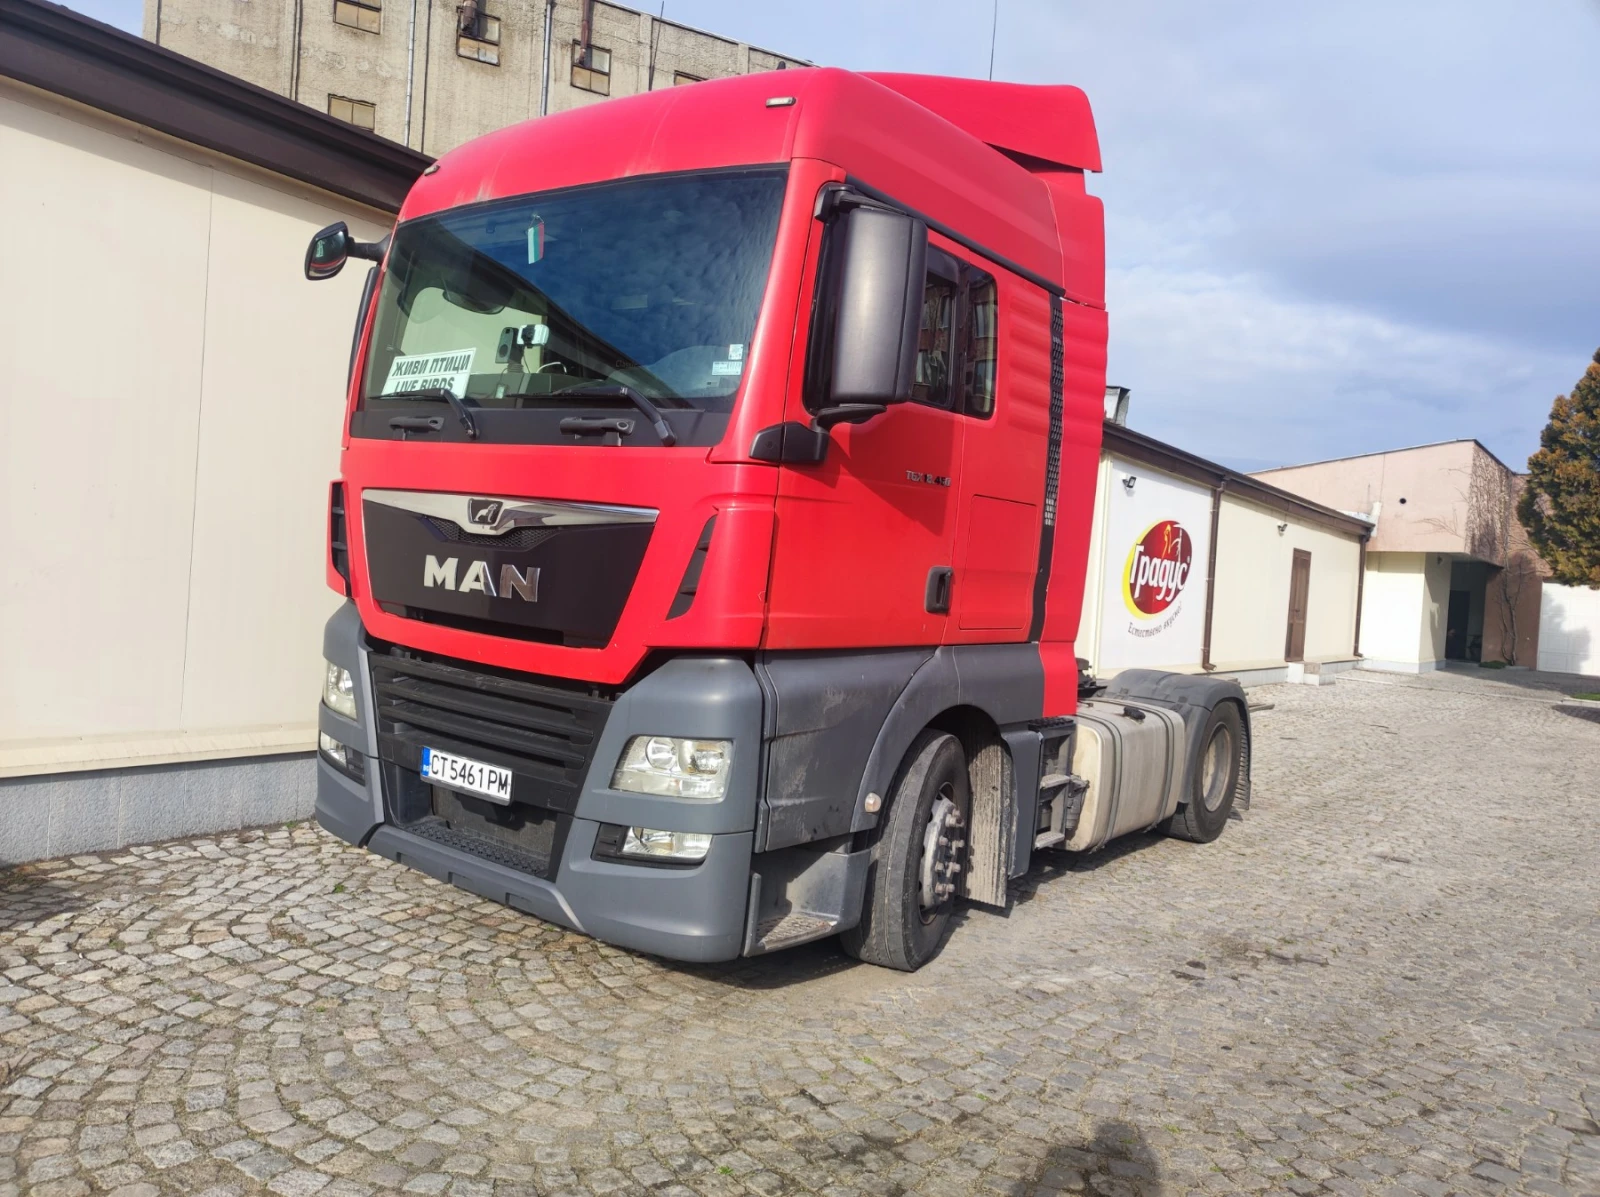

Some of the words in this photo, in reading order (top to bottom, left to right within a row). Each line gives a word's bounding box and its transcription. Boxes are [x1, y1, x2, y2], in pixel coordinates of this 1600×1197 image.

[392, 359, 429, 377] ЖИВИ
[429, 354, 471, 374] ПТИЦИ
[423, 554, 541, 603] MAN
[1130, 545, 1188, 602] Градус
